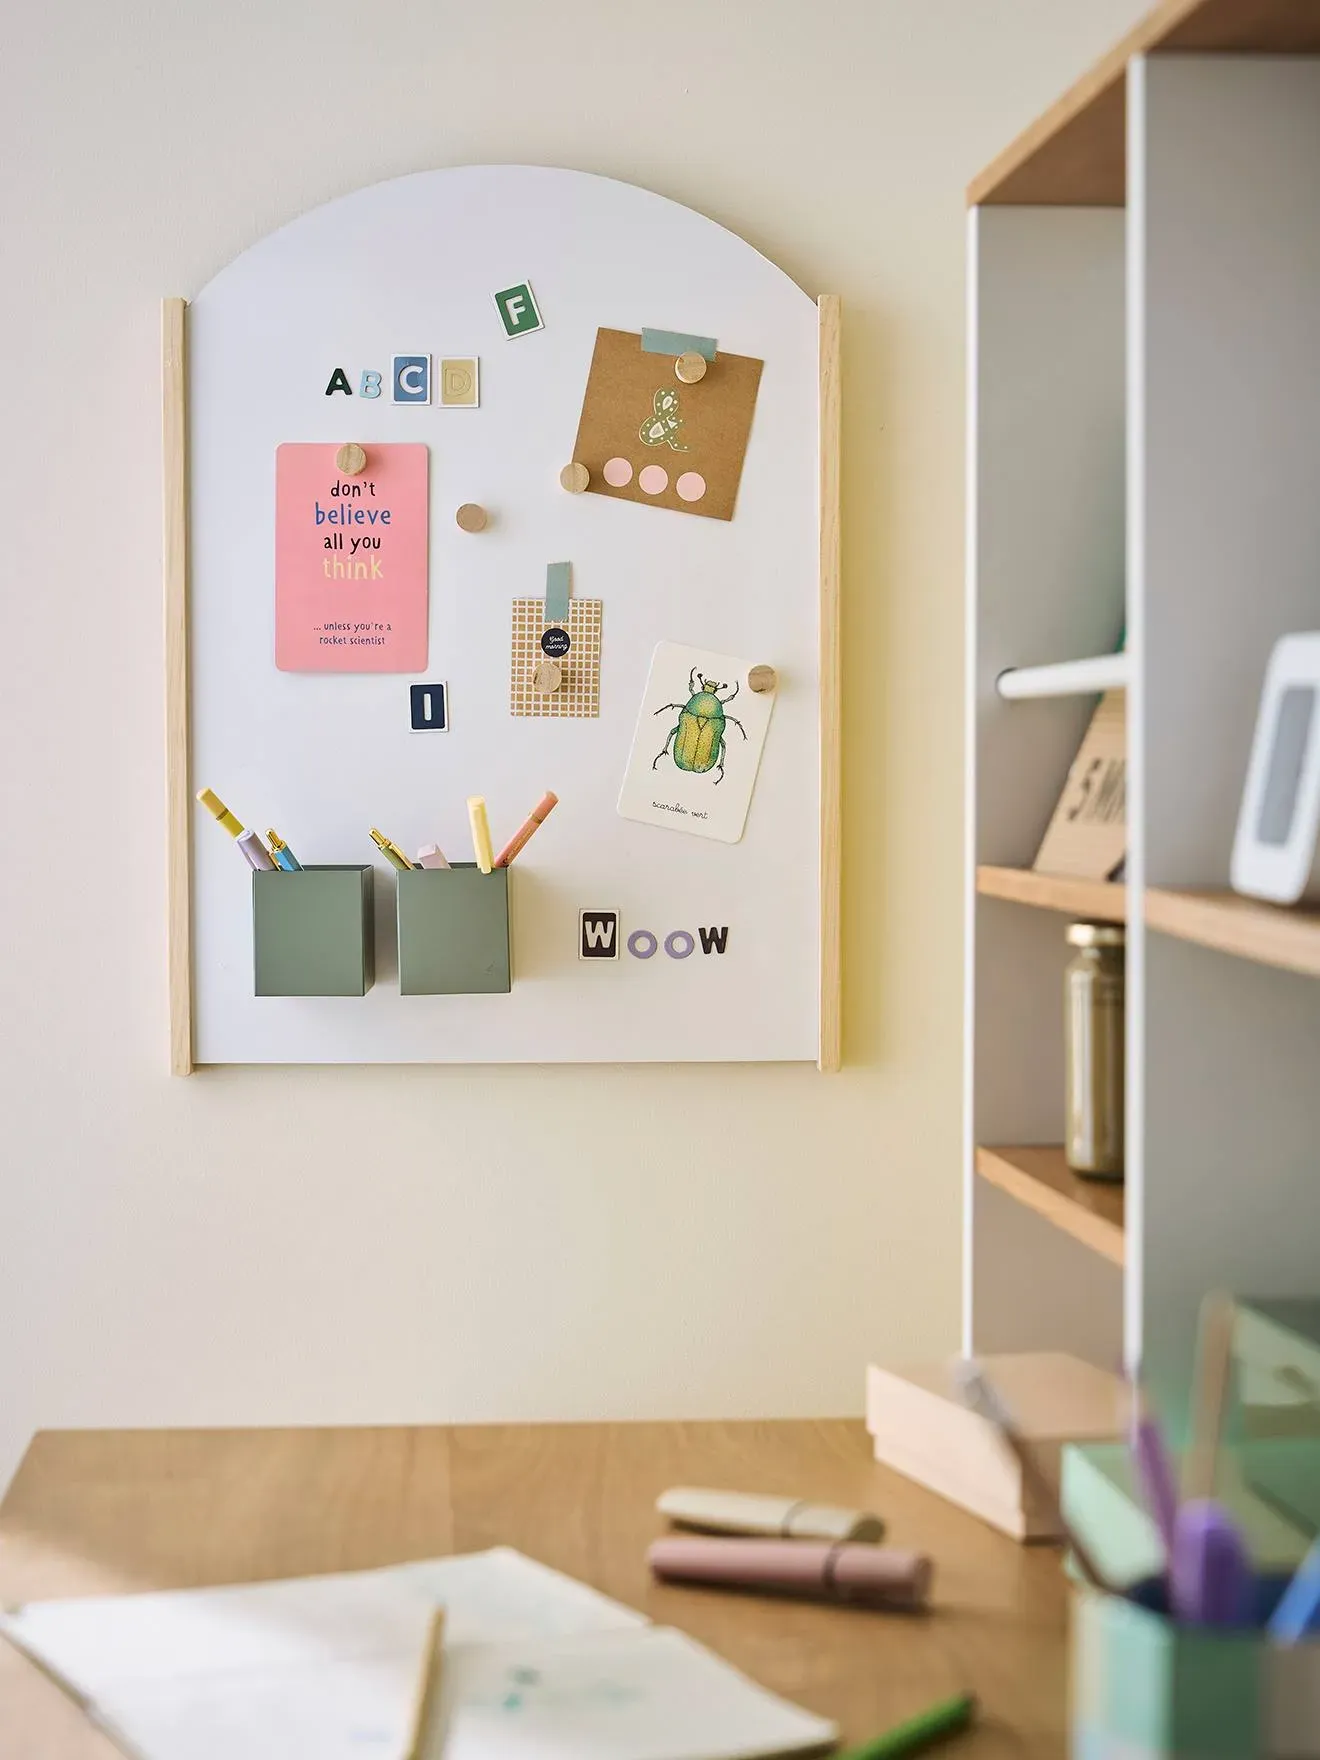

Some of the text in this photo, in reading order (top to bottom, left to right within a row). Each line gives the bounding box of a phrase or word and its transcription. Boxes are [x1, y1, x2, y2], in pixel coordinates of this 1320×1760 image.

[504, 293, 527, 326] F
[330, 479, 376, 498] don't
[315, 501, 391, 526] believe
[324, 533, 381, 555] all you
[323, 554, 384, 580] think
[324, 621, 351, 631] unless
[354, 622, 384, 634] you're
[386, 623, 393, 631] a
[319, 635, 385, 646] rocket scientist
[423, 693, 432, 721] I
